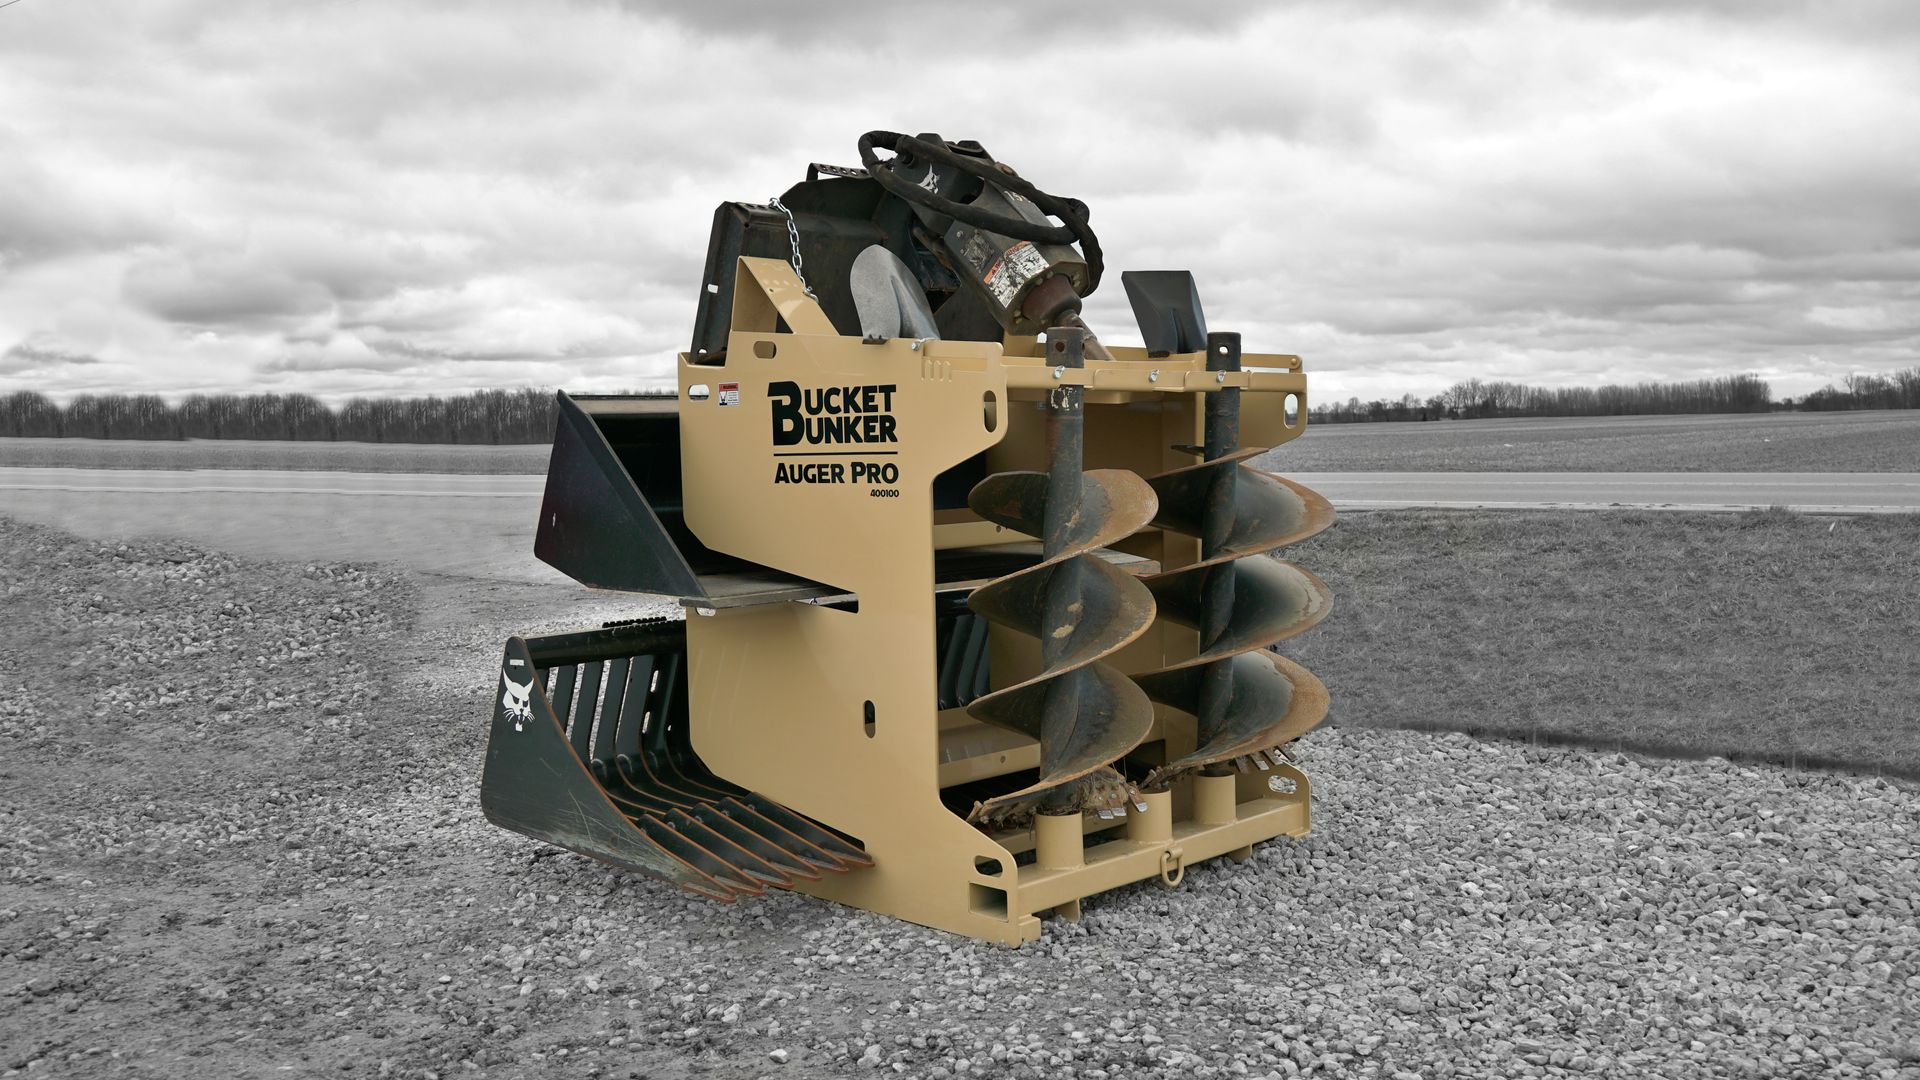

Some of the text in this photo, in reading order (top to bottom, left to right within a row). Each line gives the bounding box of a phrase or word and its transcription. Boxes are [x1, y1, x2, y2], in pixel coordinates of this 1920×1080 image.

[766, 380, 897, 418] BUCKET
[773, 460, 900, 485] AUGER PRO
[870, 488, 900, 498] 400100
